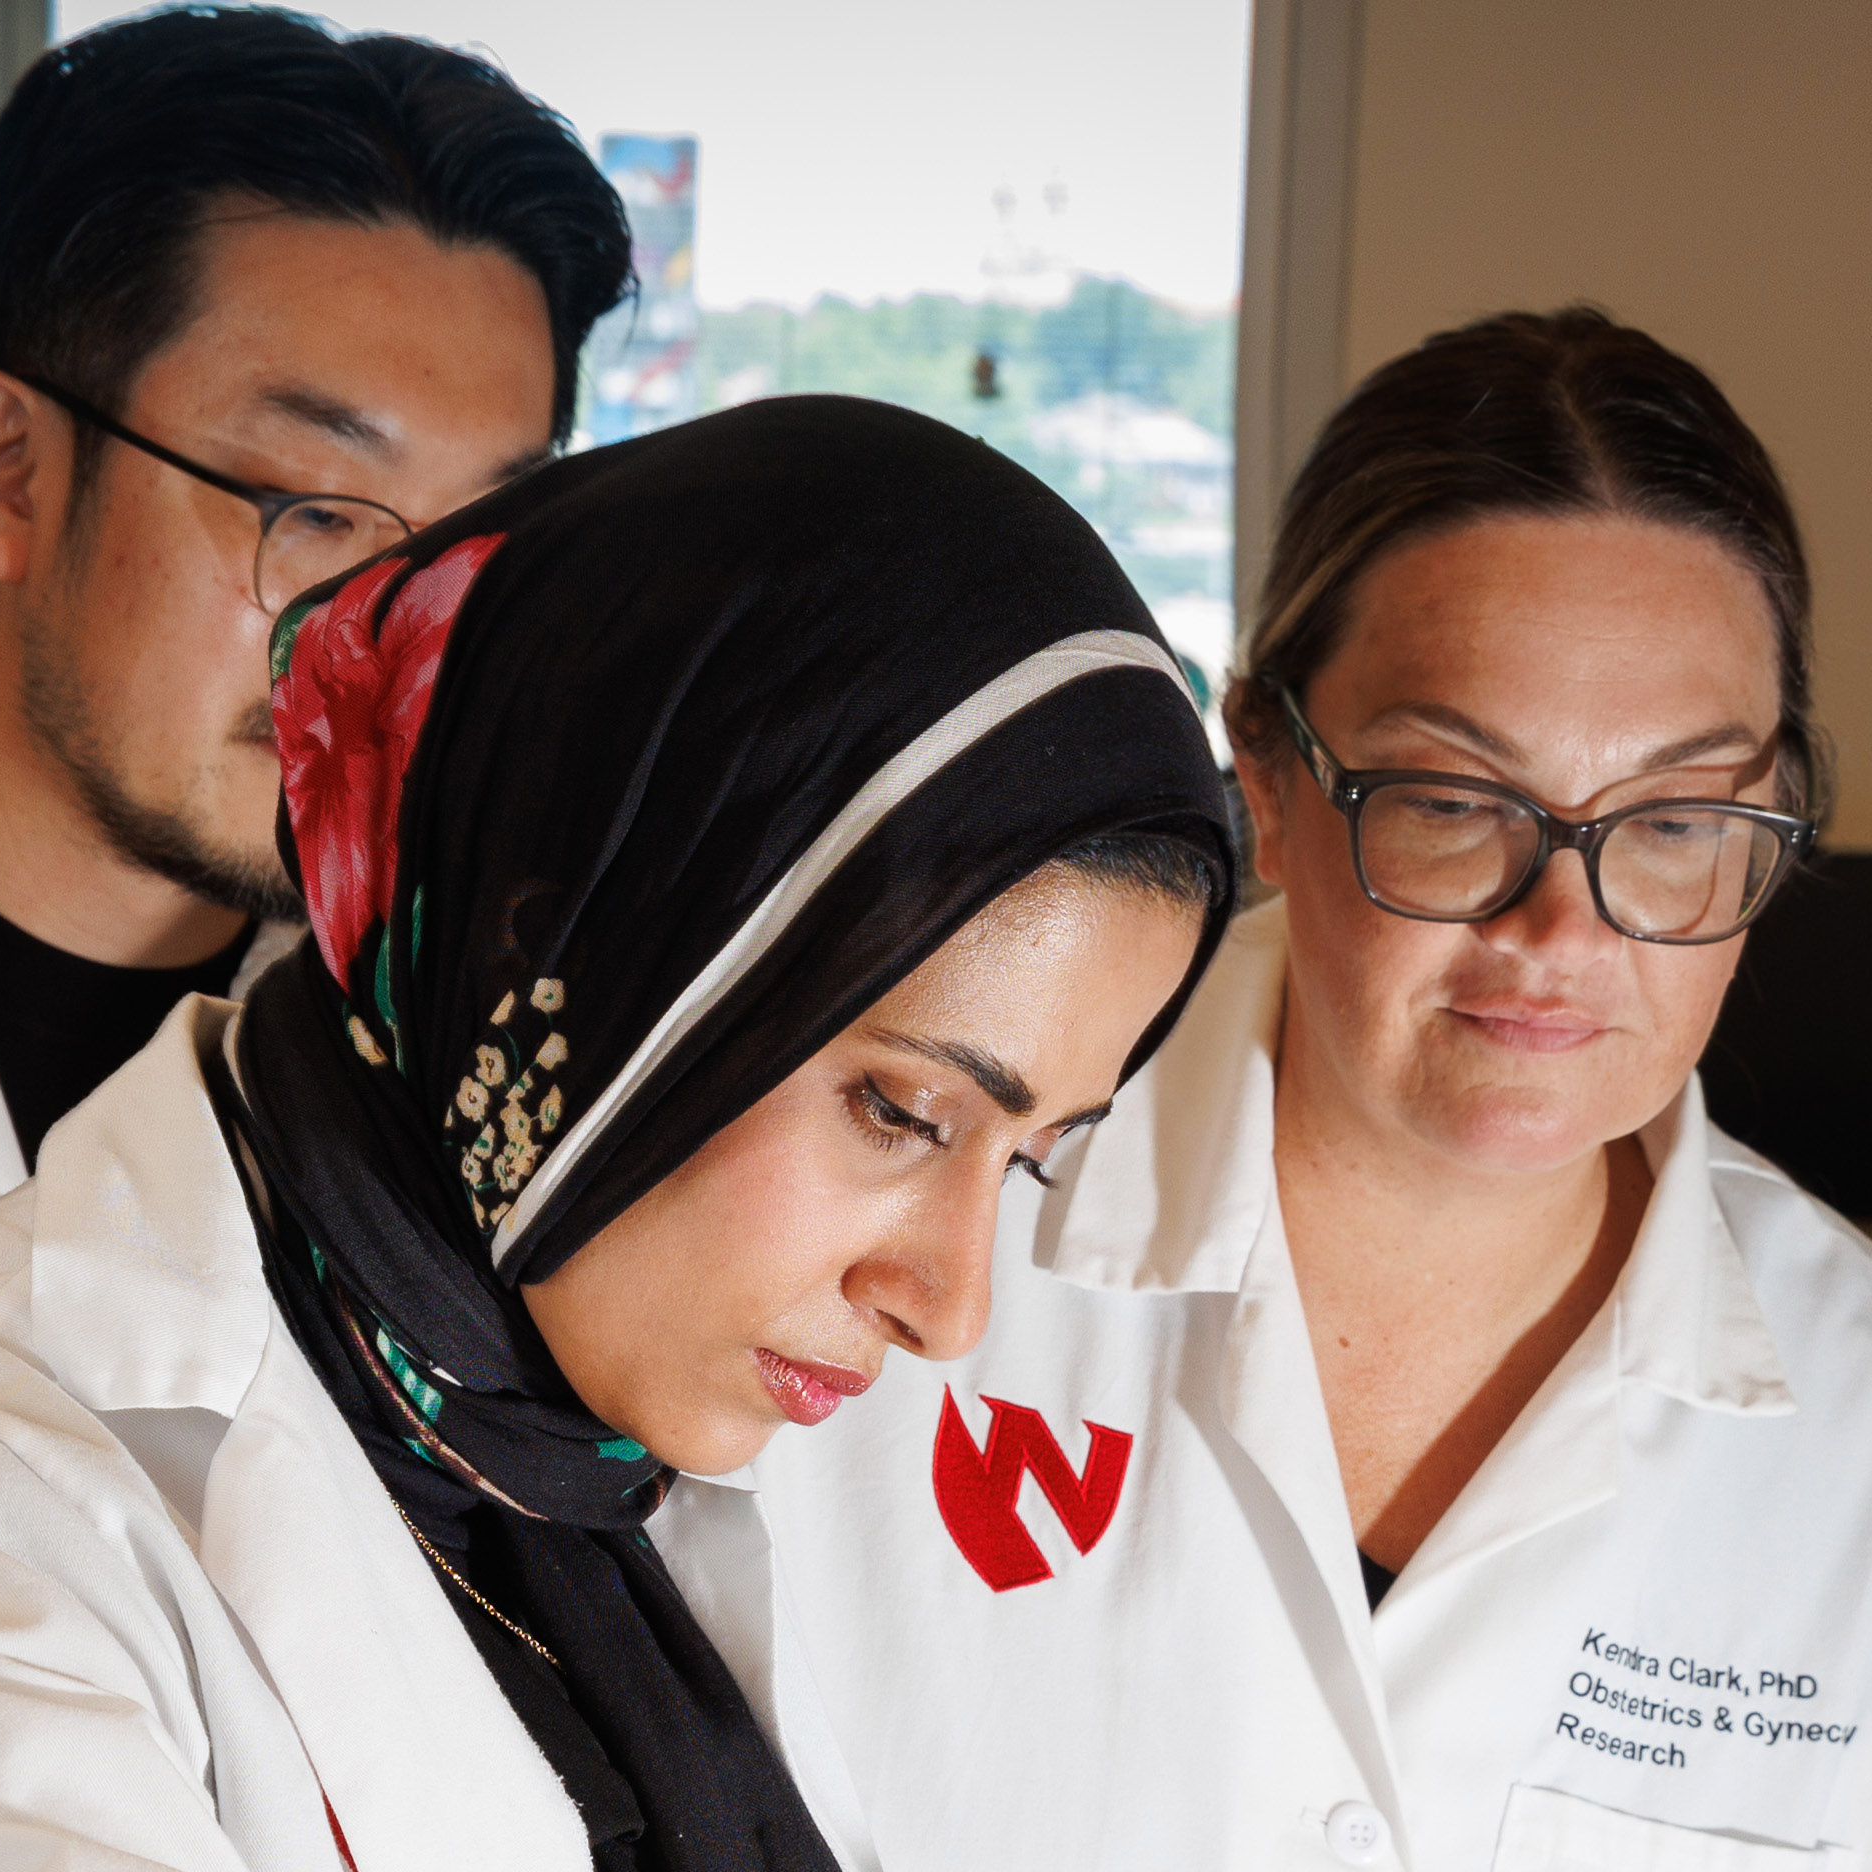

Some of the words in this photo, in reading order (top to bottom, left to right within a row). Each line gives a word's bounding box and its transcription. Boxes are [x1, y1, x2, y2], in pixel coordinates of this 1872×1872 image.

[1581, 1627, 1660, 1677] Kendra
[1669, 1656, 1750, 1698] Clark,
[1759, 1670, 1817, 1700] PhD
[1568, 1671, 1704, 1729] Obstetrics
[1714, 1706, 1733, 1734] &
[1555, 1711, 1687, 1769] Research
